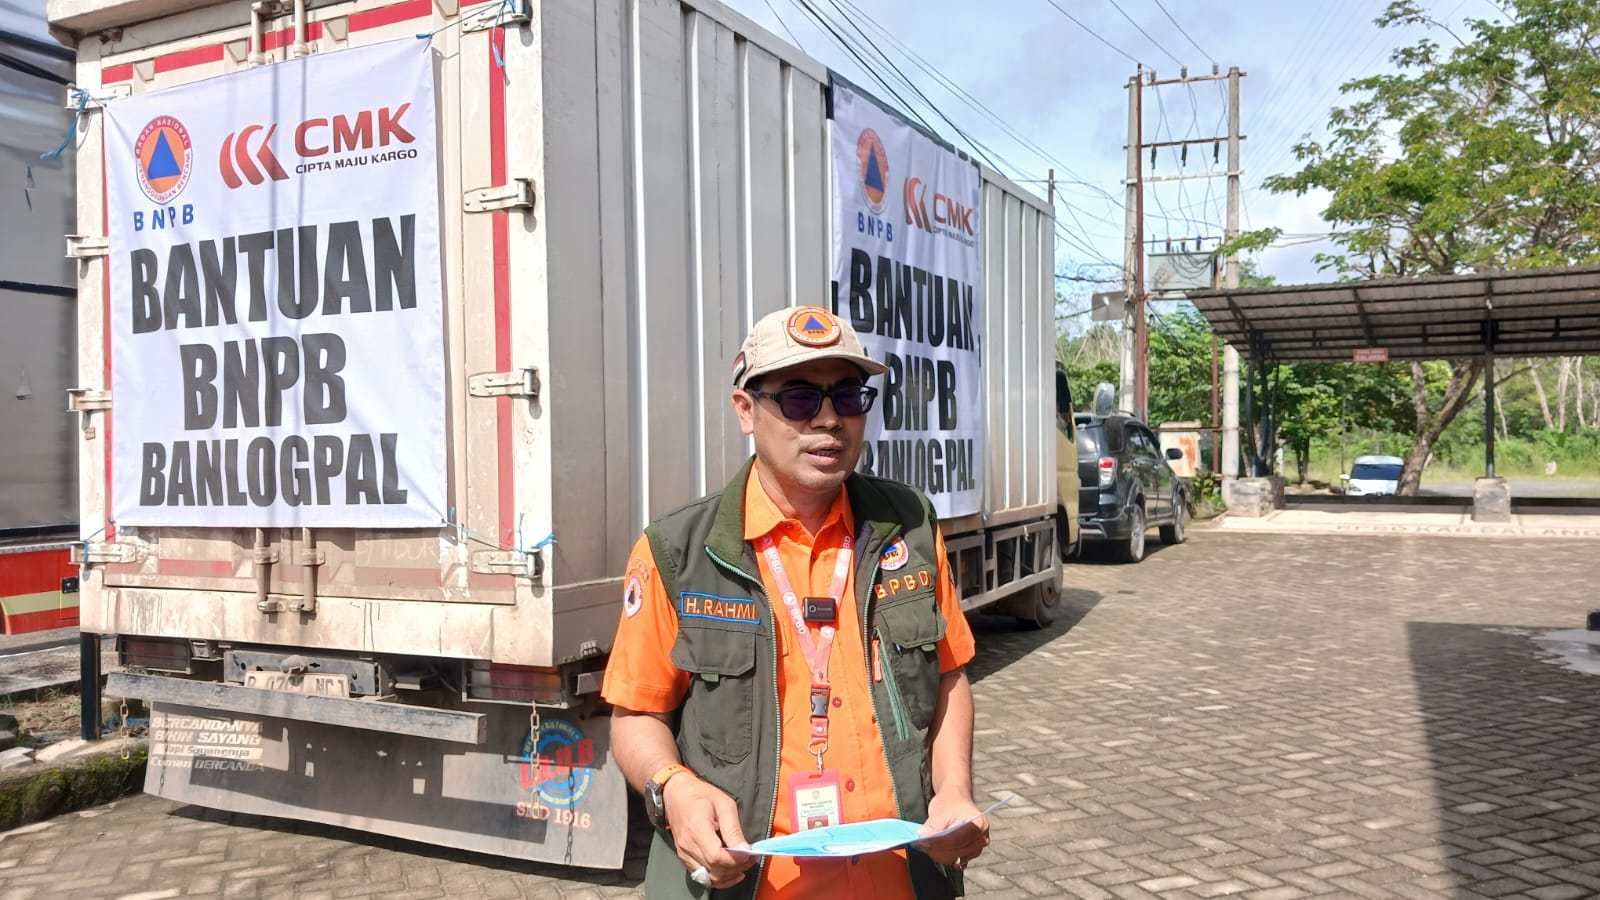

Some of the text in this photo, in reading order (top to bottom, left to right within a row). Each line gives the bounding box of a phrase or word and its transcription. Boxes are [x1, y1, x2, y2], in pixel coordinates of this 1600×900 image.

[295, 102, 417, 157] CMK
[295, 149, 418, 175] CIPTA MAJU KARGO
[133, 203, 194, 232] BNPB
[858, 212, 893, 242] BNPB
[933, 192, 974, 237] CMK
[130, 213, 417, 334] BANTUAN
[849, 247, 975, 353] BANTUAN
[180, 332, 347, 431] BNPB
[882, 351, 957, 431] BNPB
[139, 432, 409, 508] BANLOGPAL
[685, 597, 759, 620] H. RAHMI
[154, 730, 262, 746] BKIN SAYANG
